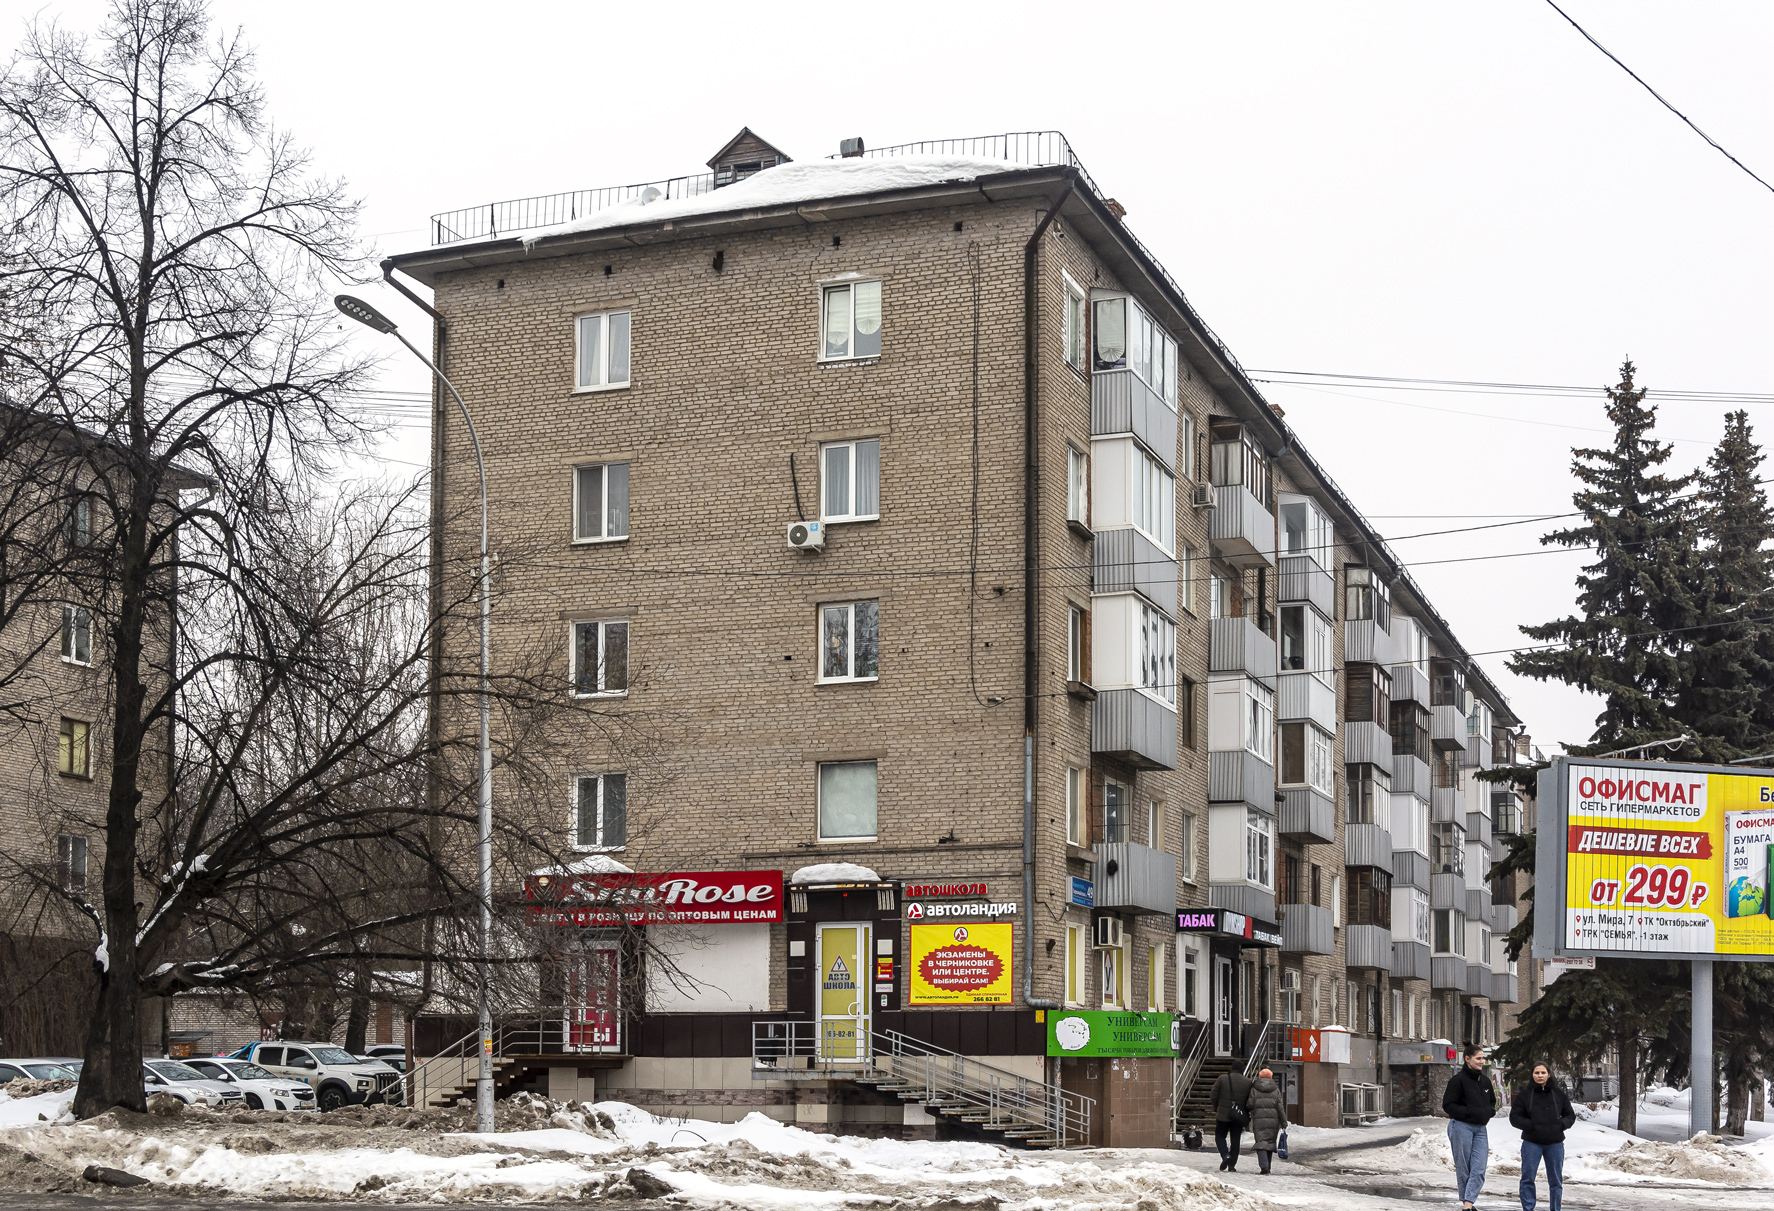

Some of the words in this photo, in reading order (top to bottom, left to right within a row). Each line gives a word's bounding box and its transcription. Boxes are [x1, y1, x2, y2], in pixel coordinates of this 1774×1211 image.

[1579, 777, 1702, 804] ОФИСМАГ
[1580, 800, 1608, 812] СЕТЬ
[1610, 802, 1700, 817] ГИПЕРМАРКЕТОВ
[1578, 830, 1657, 852] ДЕШЕВЛЕ
[1734, 834, 1771, 845] БУМАГА
[1734, 846, 1745, 855] А4
[1734, 857, 1749, 866] 500
[906, 883, 988, 897] автошкола
[1624, 866, 1689, 905] 299
[926, 902, 1017, 917] автоландия
[578, 913, 586, 922] В
[648, 911, 665, 920] ПО
[668, 910, 731, 920] ОПТОВЫМ
[733, 910, 777, 920] ЦЕНАМ
[1178, 914, 1215, 927] ТАБАК
[1583, 915, 1596, 926] ул.
[1598, 914, 1626, 928] Мира,
[1628, 915, 1634, 925] 7
[1644, 917, 1654, 926] ТК
[1656, 917, 1710, 928] "Октябрьский"
[1253, 929, 1270, 942] ТАБАК
[1582, 929, 1598, 938] ТРК
[1600, 929, 1638, 940] "СЕМЬЯ",
[1640, 932, 1647, 940] -1
[1649, 933, 1669, 941] этаж
[936, 959, 994, 967] ЧЕРНИКОВКЕ
[828, 973, 851, 981] АВТО
[932, 968, 951, 976] ИЛИ
[953, 968, 990, 976] ЦЕНТРЕ.
[823, 981, 856, 990] ШКОЛА
[1107, 1016, 1158, 1027] УНИВЕРСАМ
[1112, 1031, 1162, 1042] УНИВЕРСАМ
